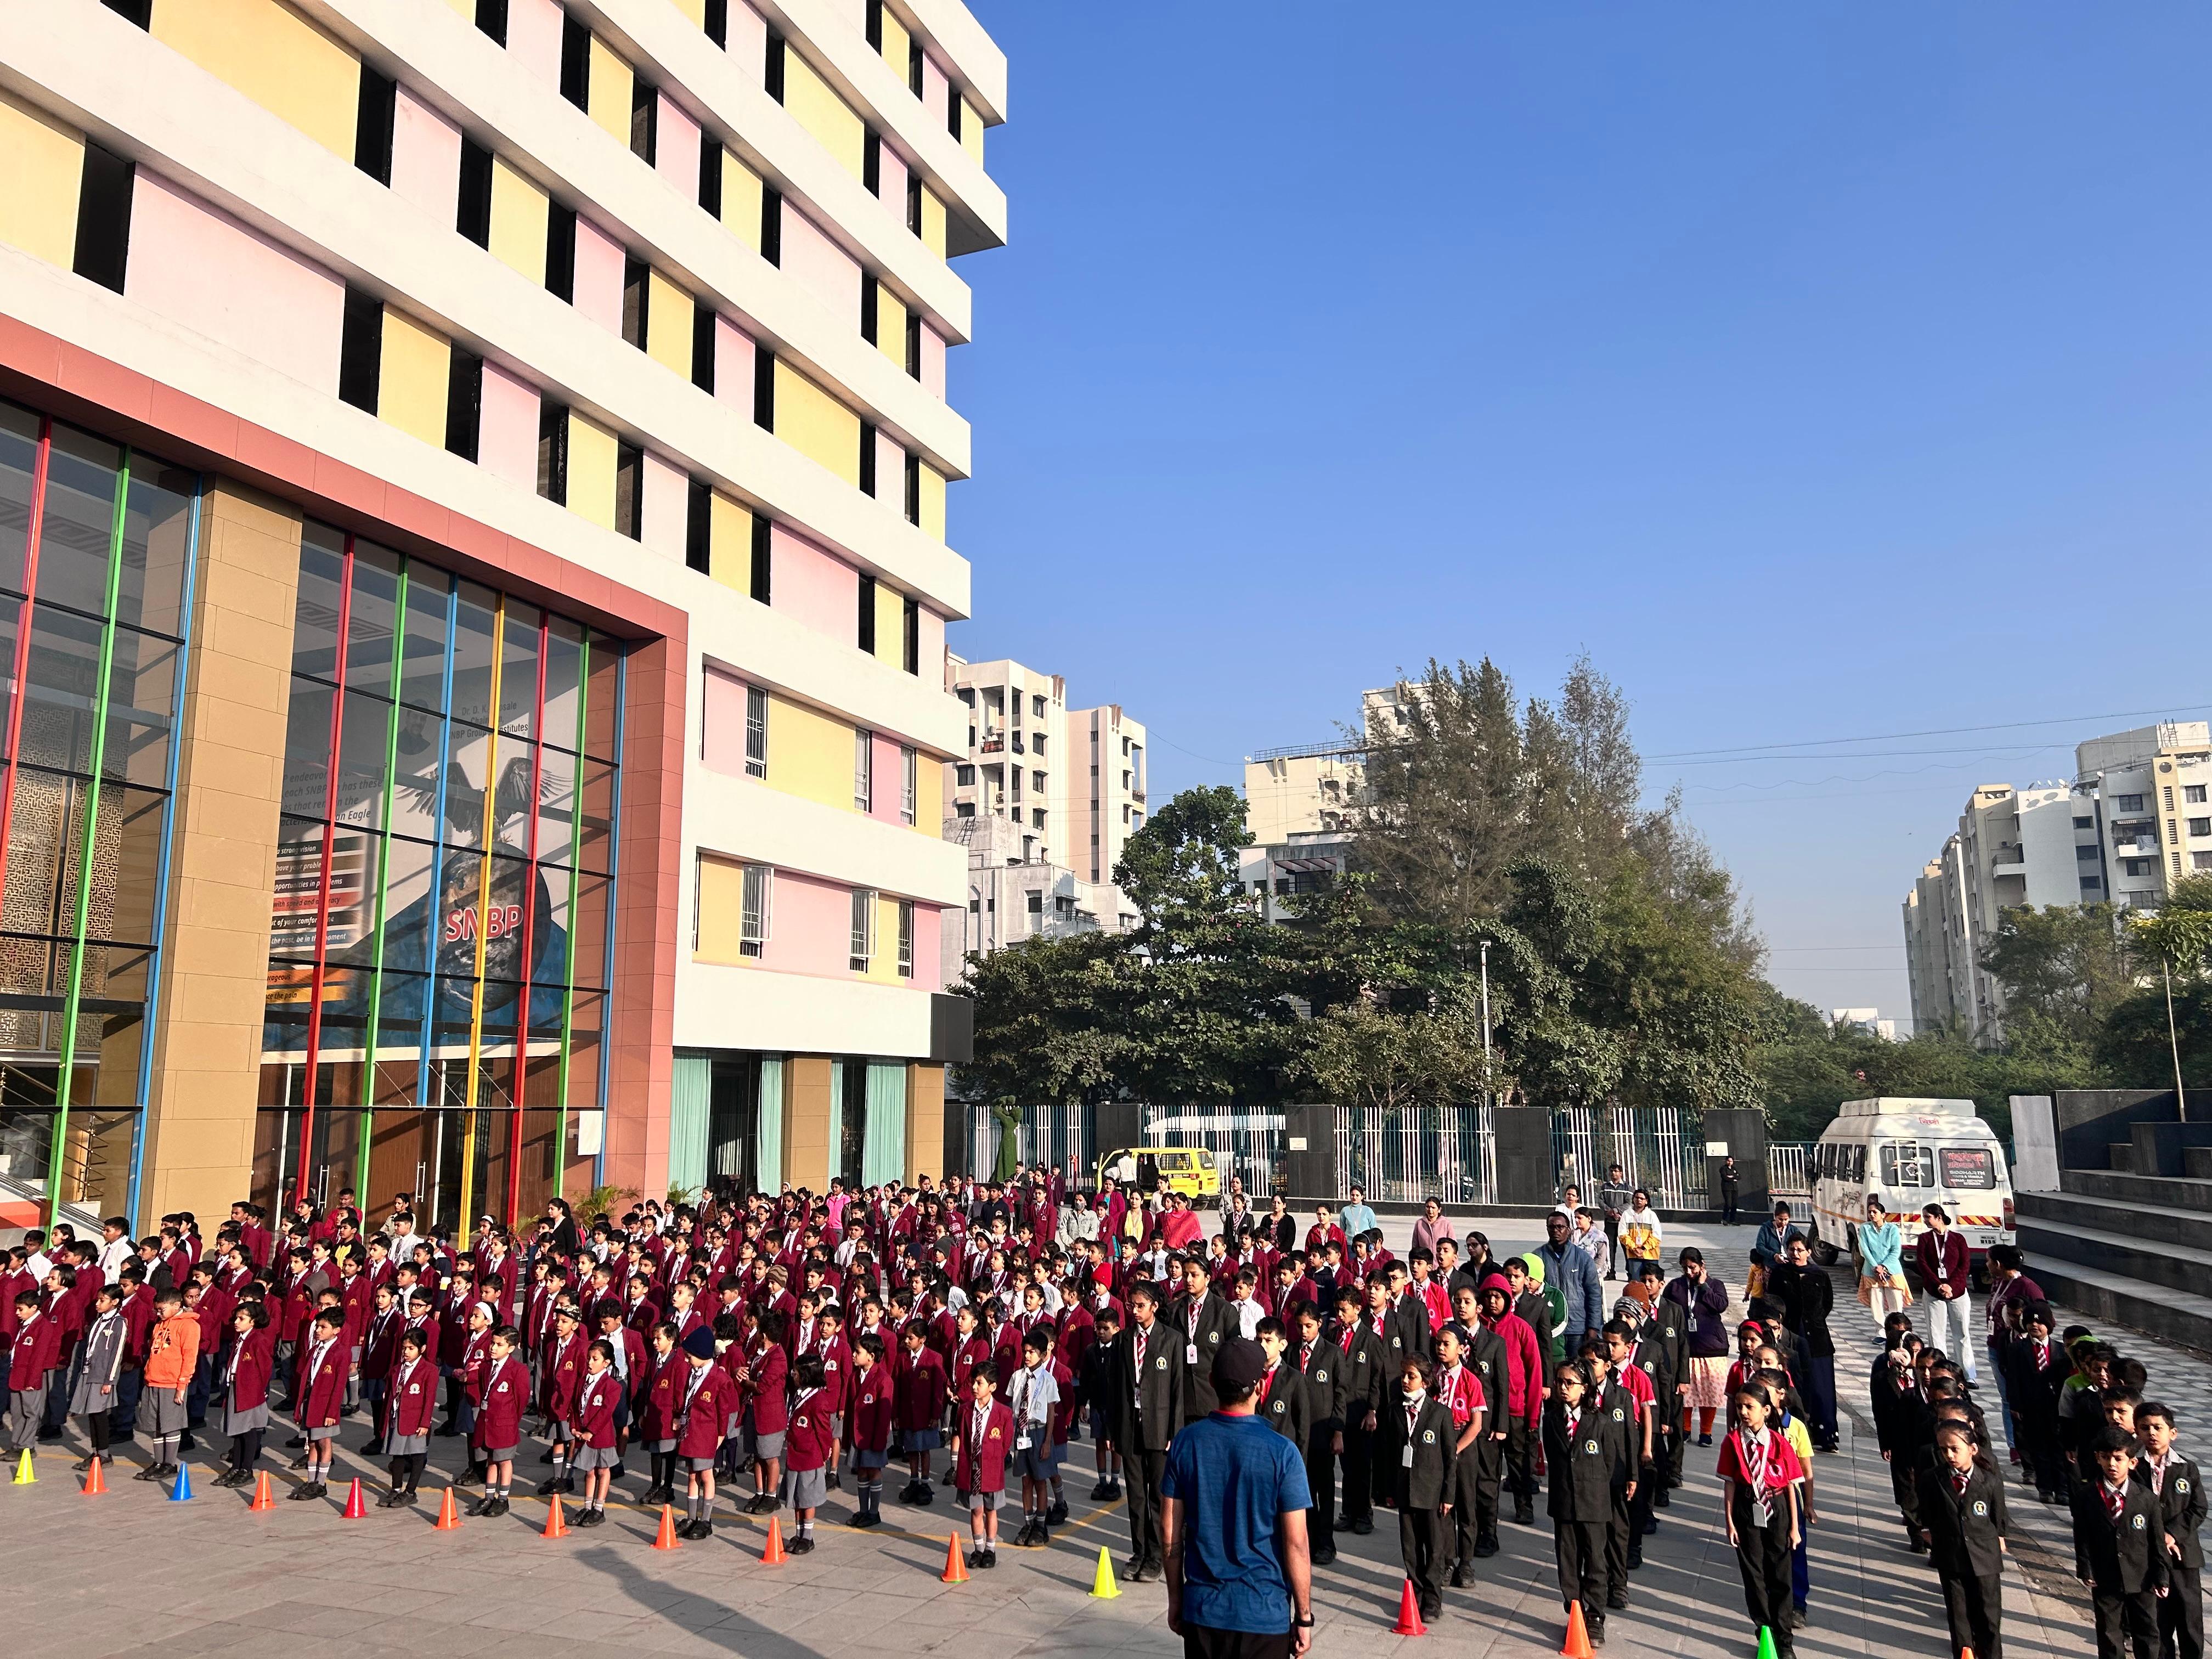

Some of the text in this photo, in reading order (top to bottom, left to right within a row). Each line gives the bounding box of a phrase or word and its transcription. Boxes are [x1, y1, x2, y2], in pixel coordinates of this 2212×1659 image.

[450, 730, 465, 739] NBP
[500, 723, 528, 732] nstitutes
[285, 786, 303, 797] each
[342, 782, 356, 791] has
[359, 780, 382, 789] these
[294, 802, 311, 810] that
[345, 797, 358, 805] the
[348, 809, 371, 821] Eagle
[290, 864, 302, 872] your
[303, 861, 321, 871] proble
[274, 881, 308, 891] pportunities
[277, 918, 284, 927] of
[284, 919, 297, 927] your
[445, 905, 524, 942] SNBP
[284, 991, 297, 1001] pain
